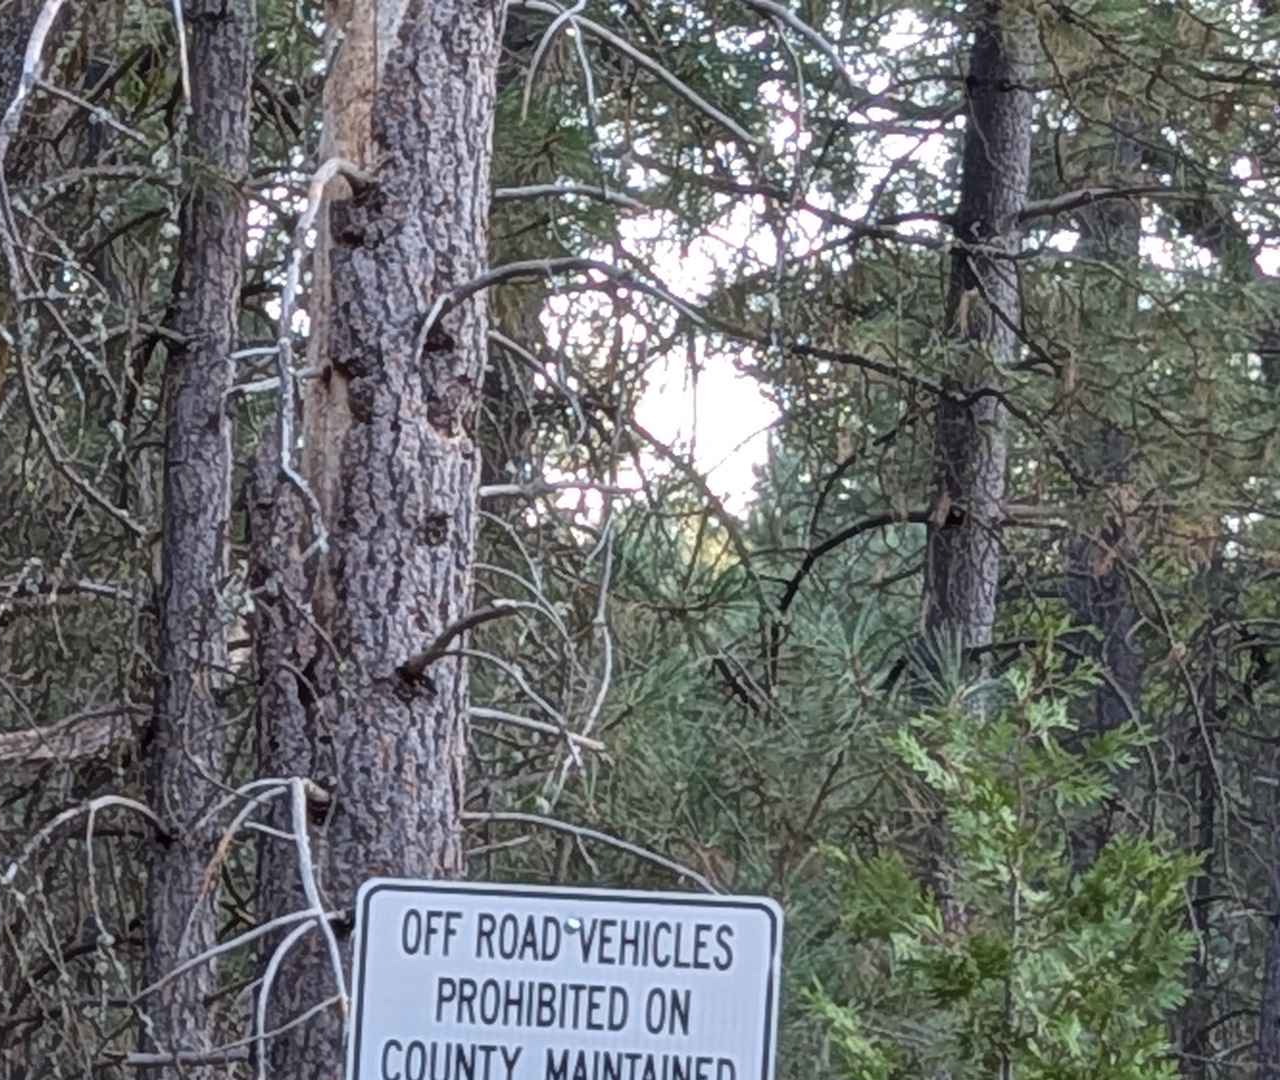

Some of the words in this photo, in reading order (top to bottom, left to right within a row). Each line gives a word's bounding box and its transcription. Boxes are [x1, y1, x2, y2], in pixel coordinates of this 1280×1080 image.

[401, 908, 463, 957] OFF
[475, 912, 561, 963] ROAD
[577, 917, 735, 971] VEHICLES
[435, 977, 629, 1032] PROHIBITED
[645, 987, 692, 1036] ON
